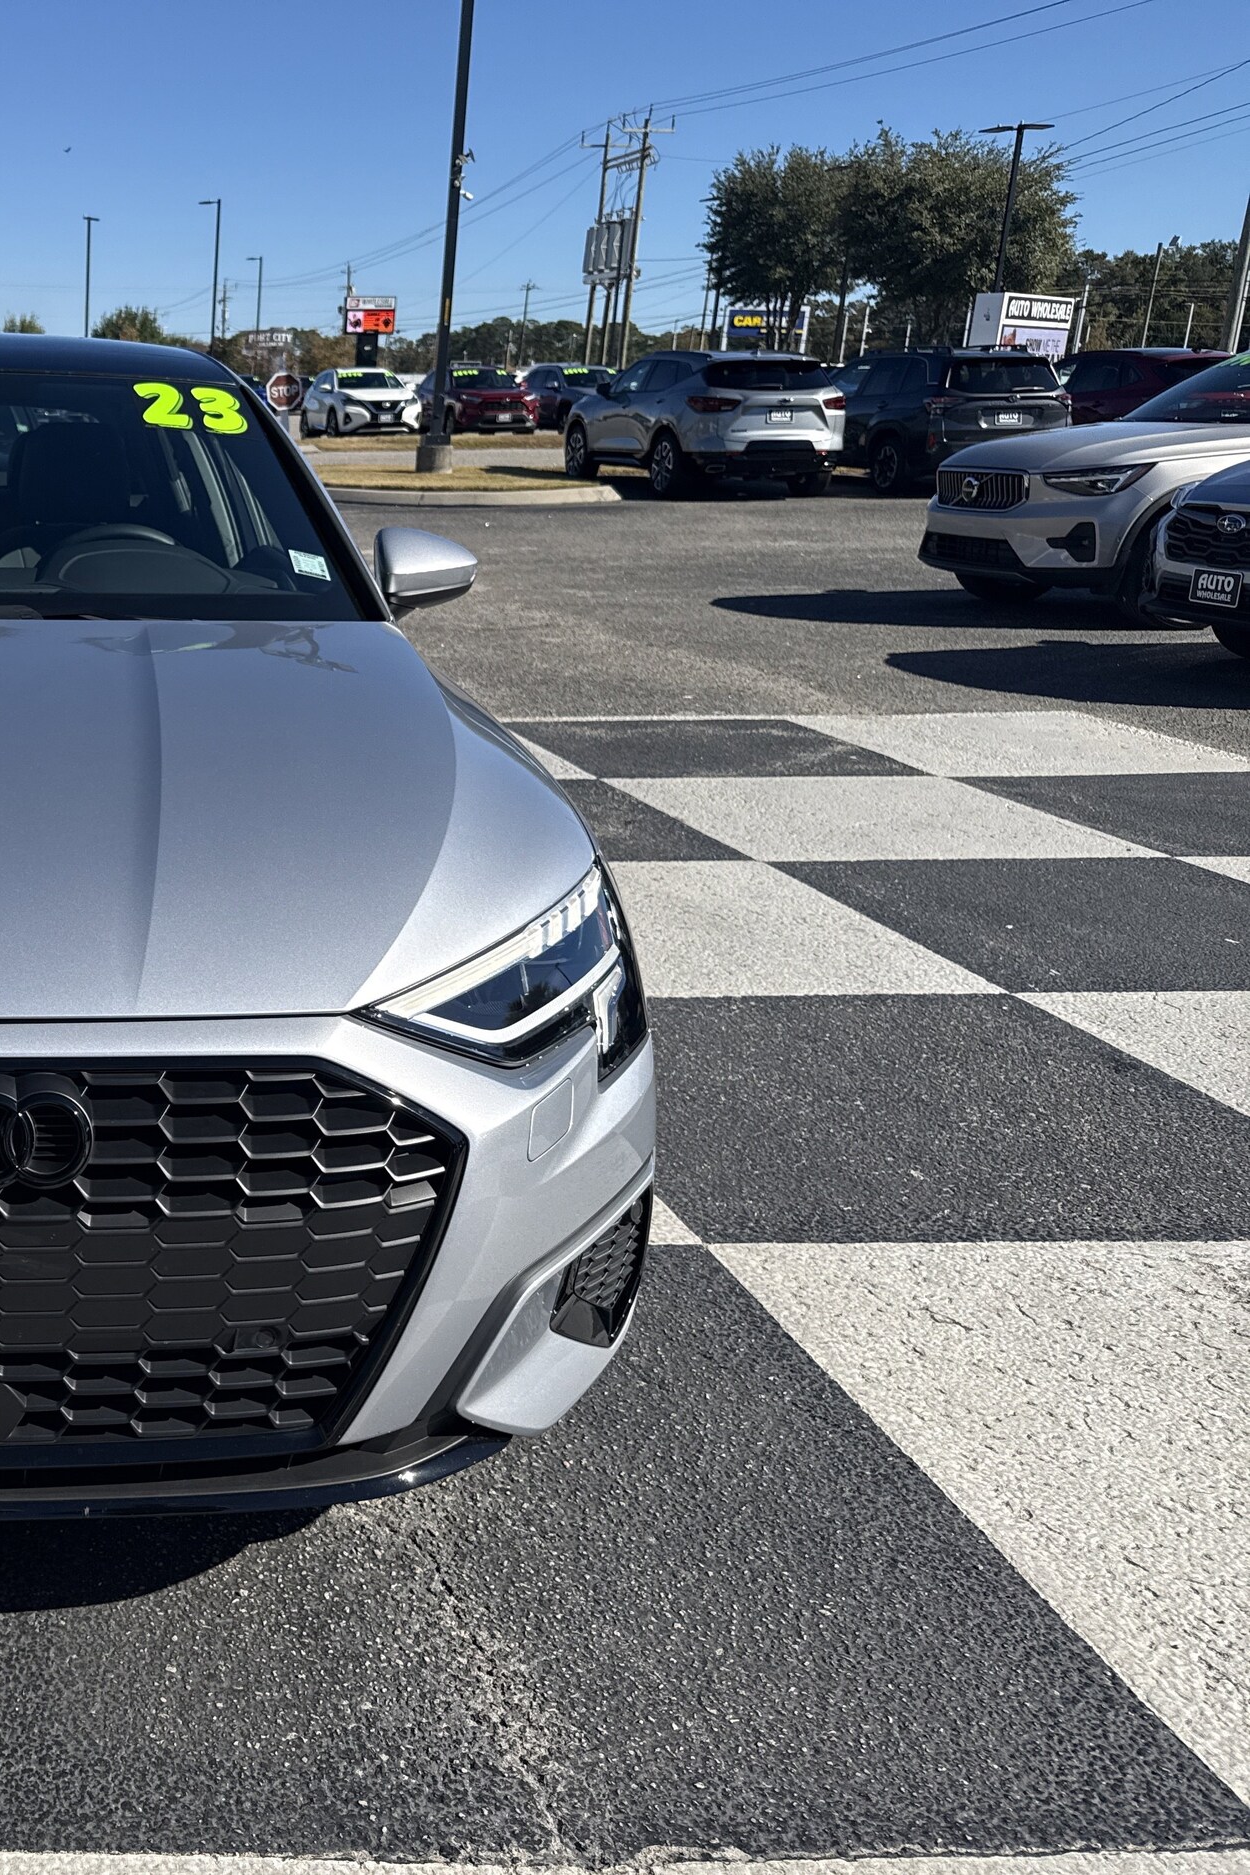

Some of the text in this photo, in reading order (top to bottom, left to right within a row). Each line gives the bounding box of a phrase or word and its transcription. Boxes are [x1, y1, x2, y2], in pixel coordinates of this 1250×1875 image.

[1008, 299, 1072, 320] AUTO WHOLESALE
[272, 332, 293, 343] CITY
[270, 385, 299, 398] STOP
[133, 382, 248, 434] 23
[1197, 573, 1235, 592] AUTO
[1196, 589, 1232, 602] WHOLESALE
